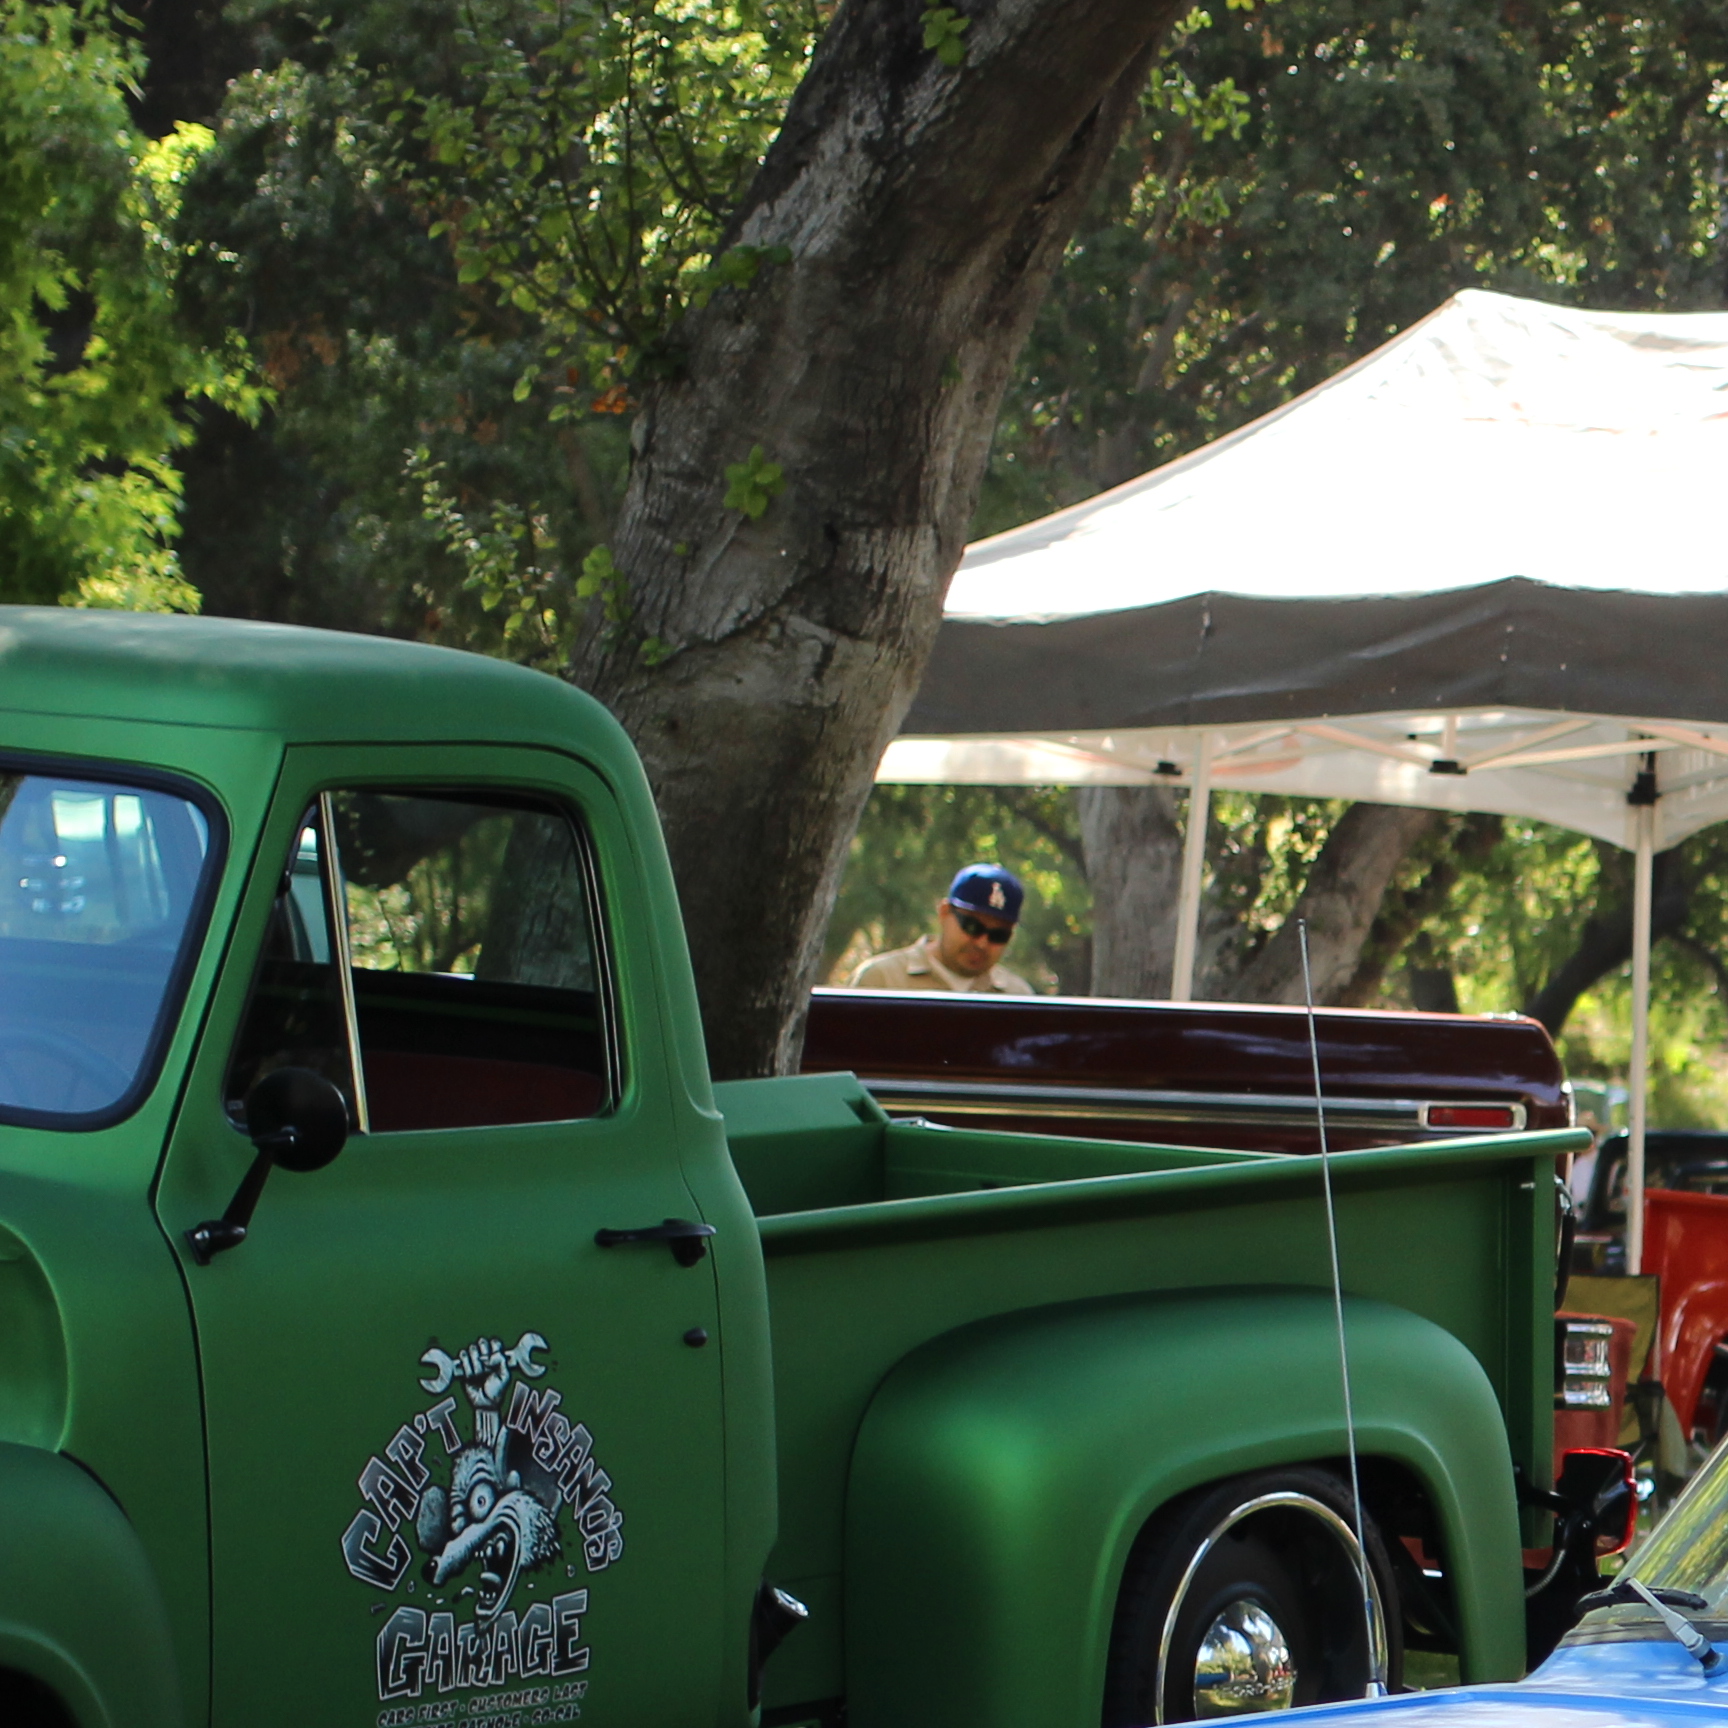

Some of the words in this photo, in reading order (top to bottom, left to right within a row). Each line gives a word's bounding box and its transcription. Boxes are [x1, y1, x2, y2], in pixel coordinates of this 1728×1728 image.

[341, 1396, 462, 1591] CAP'T
[506, 1380, 625, 1572] INSANO'S
[376, 1588, 590, 1701] GARAGE
[376, 1706, 415, 1728] CARS
[417, 1700, 459, 1721] FIRST
[467, 1686, 550, 1714] CUSTOMERS
[552, 1680, 589, 1702] LAST
